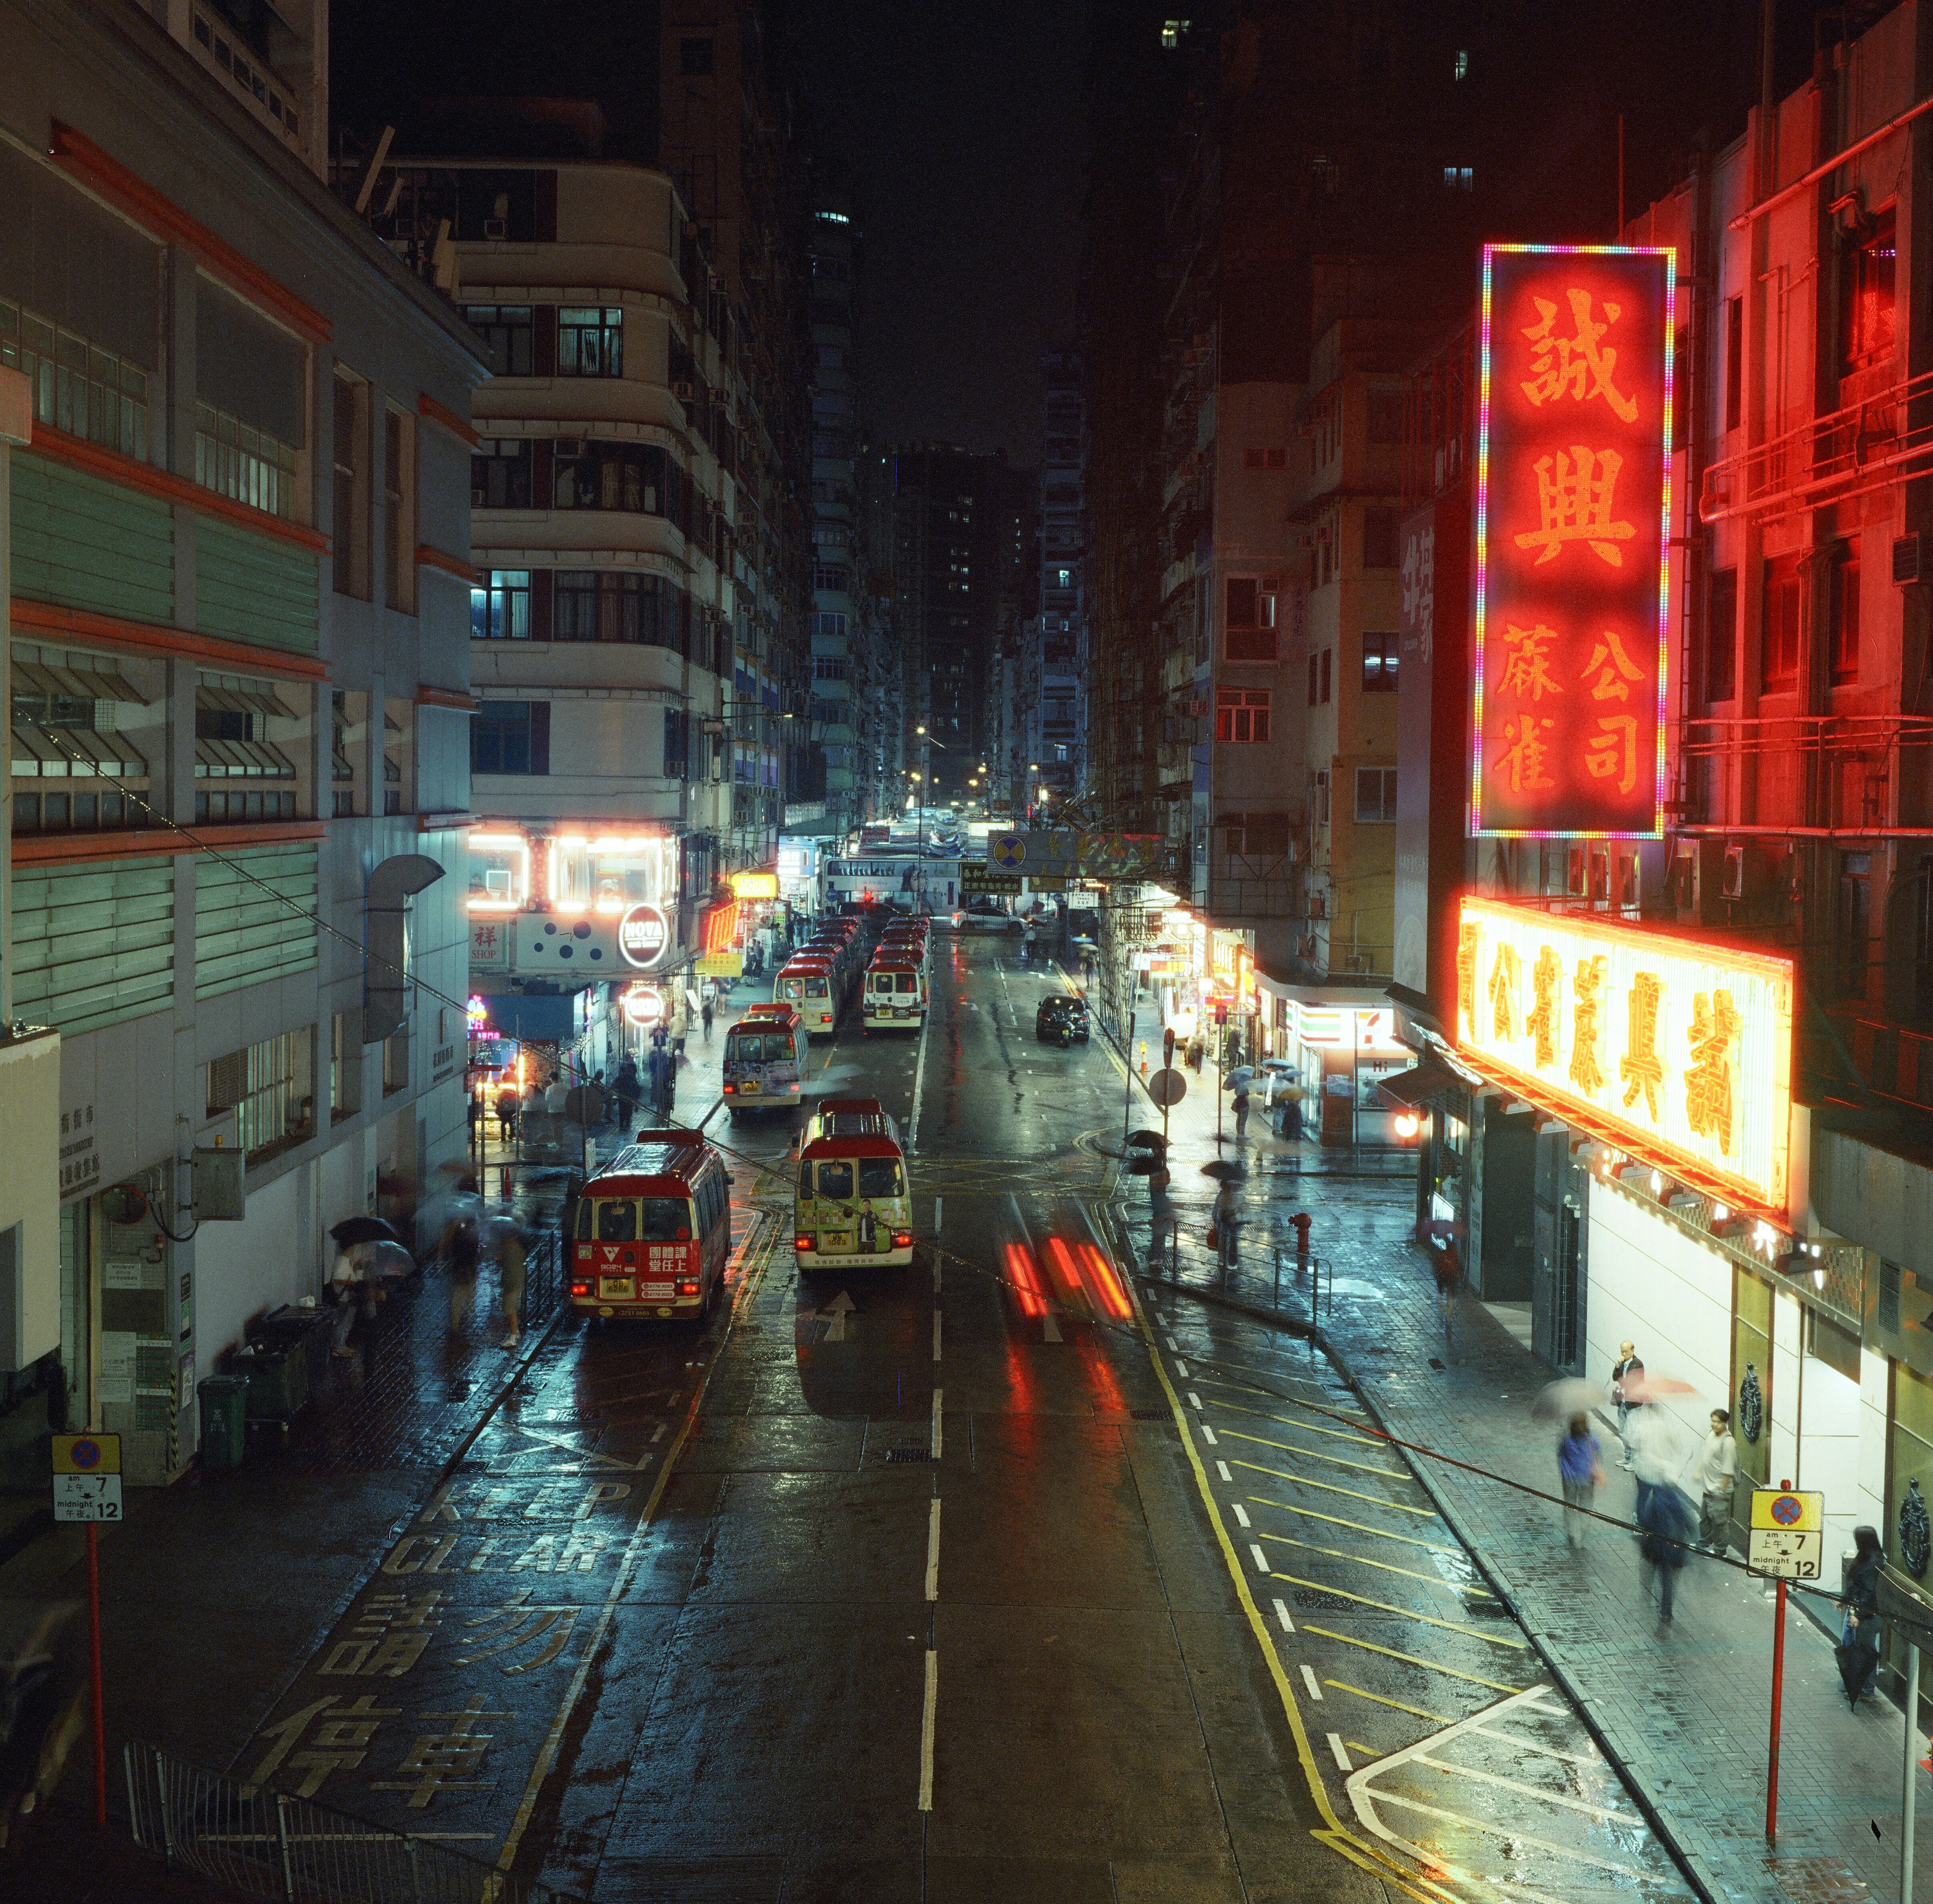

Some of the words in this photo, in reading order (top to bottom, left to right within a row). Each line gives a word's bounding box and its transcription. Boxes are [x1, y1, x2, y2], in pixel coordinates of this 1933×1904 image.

[1514, 288, 1638, 566] 誠興
[1581, 631, 1645, 794] 公司
[474, 926, 496, 947] 祥
[624, 922, 662, 937] NOVA
[472, 950, 496, 959] SHOP
[628, 998, 660, 1008] NOVA
[1359, 1012, 1380, 1044] 7
[649, 1246, 687, 1259] 團體課
[649, 1260, 687, 1272] 堂任上
[65, 1483, 84, 1492] 上午
[96, 1477, 107, 1492] 7
[420, 1482, 631, 1521] KEEP
[66, 1509, 85, 1518] 午夜
[97, 1502, 118, 1518] 12
[1762, 1540, 1782, 1549] 上午
[1795, 1534, 1806, 1550] 7
[381, 1532, 610, 1574] CLEAR
[1795, 1561, 1815, 1576] 12
[316, 1587, 582, 1677] 請勿
[238, 1693, 516, 1808] 停車
